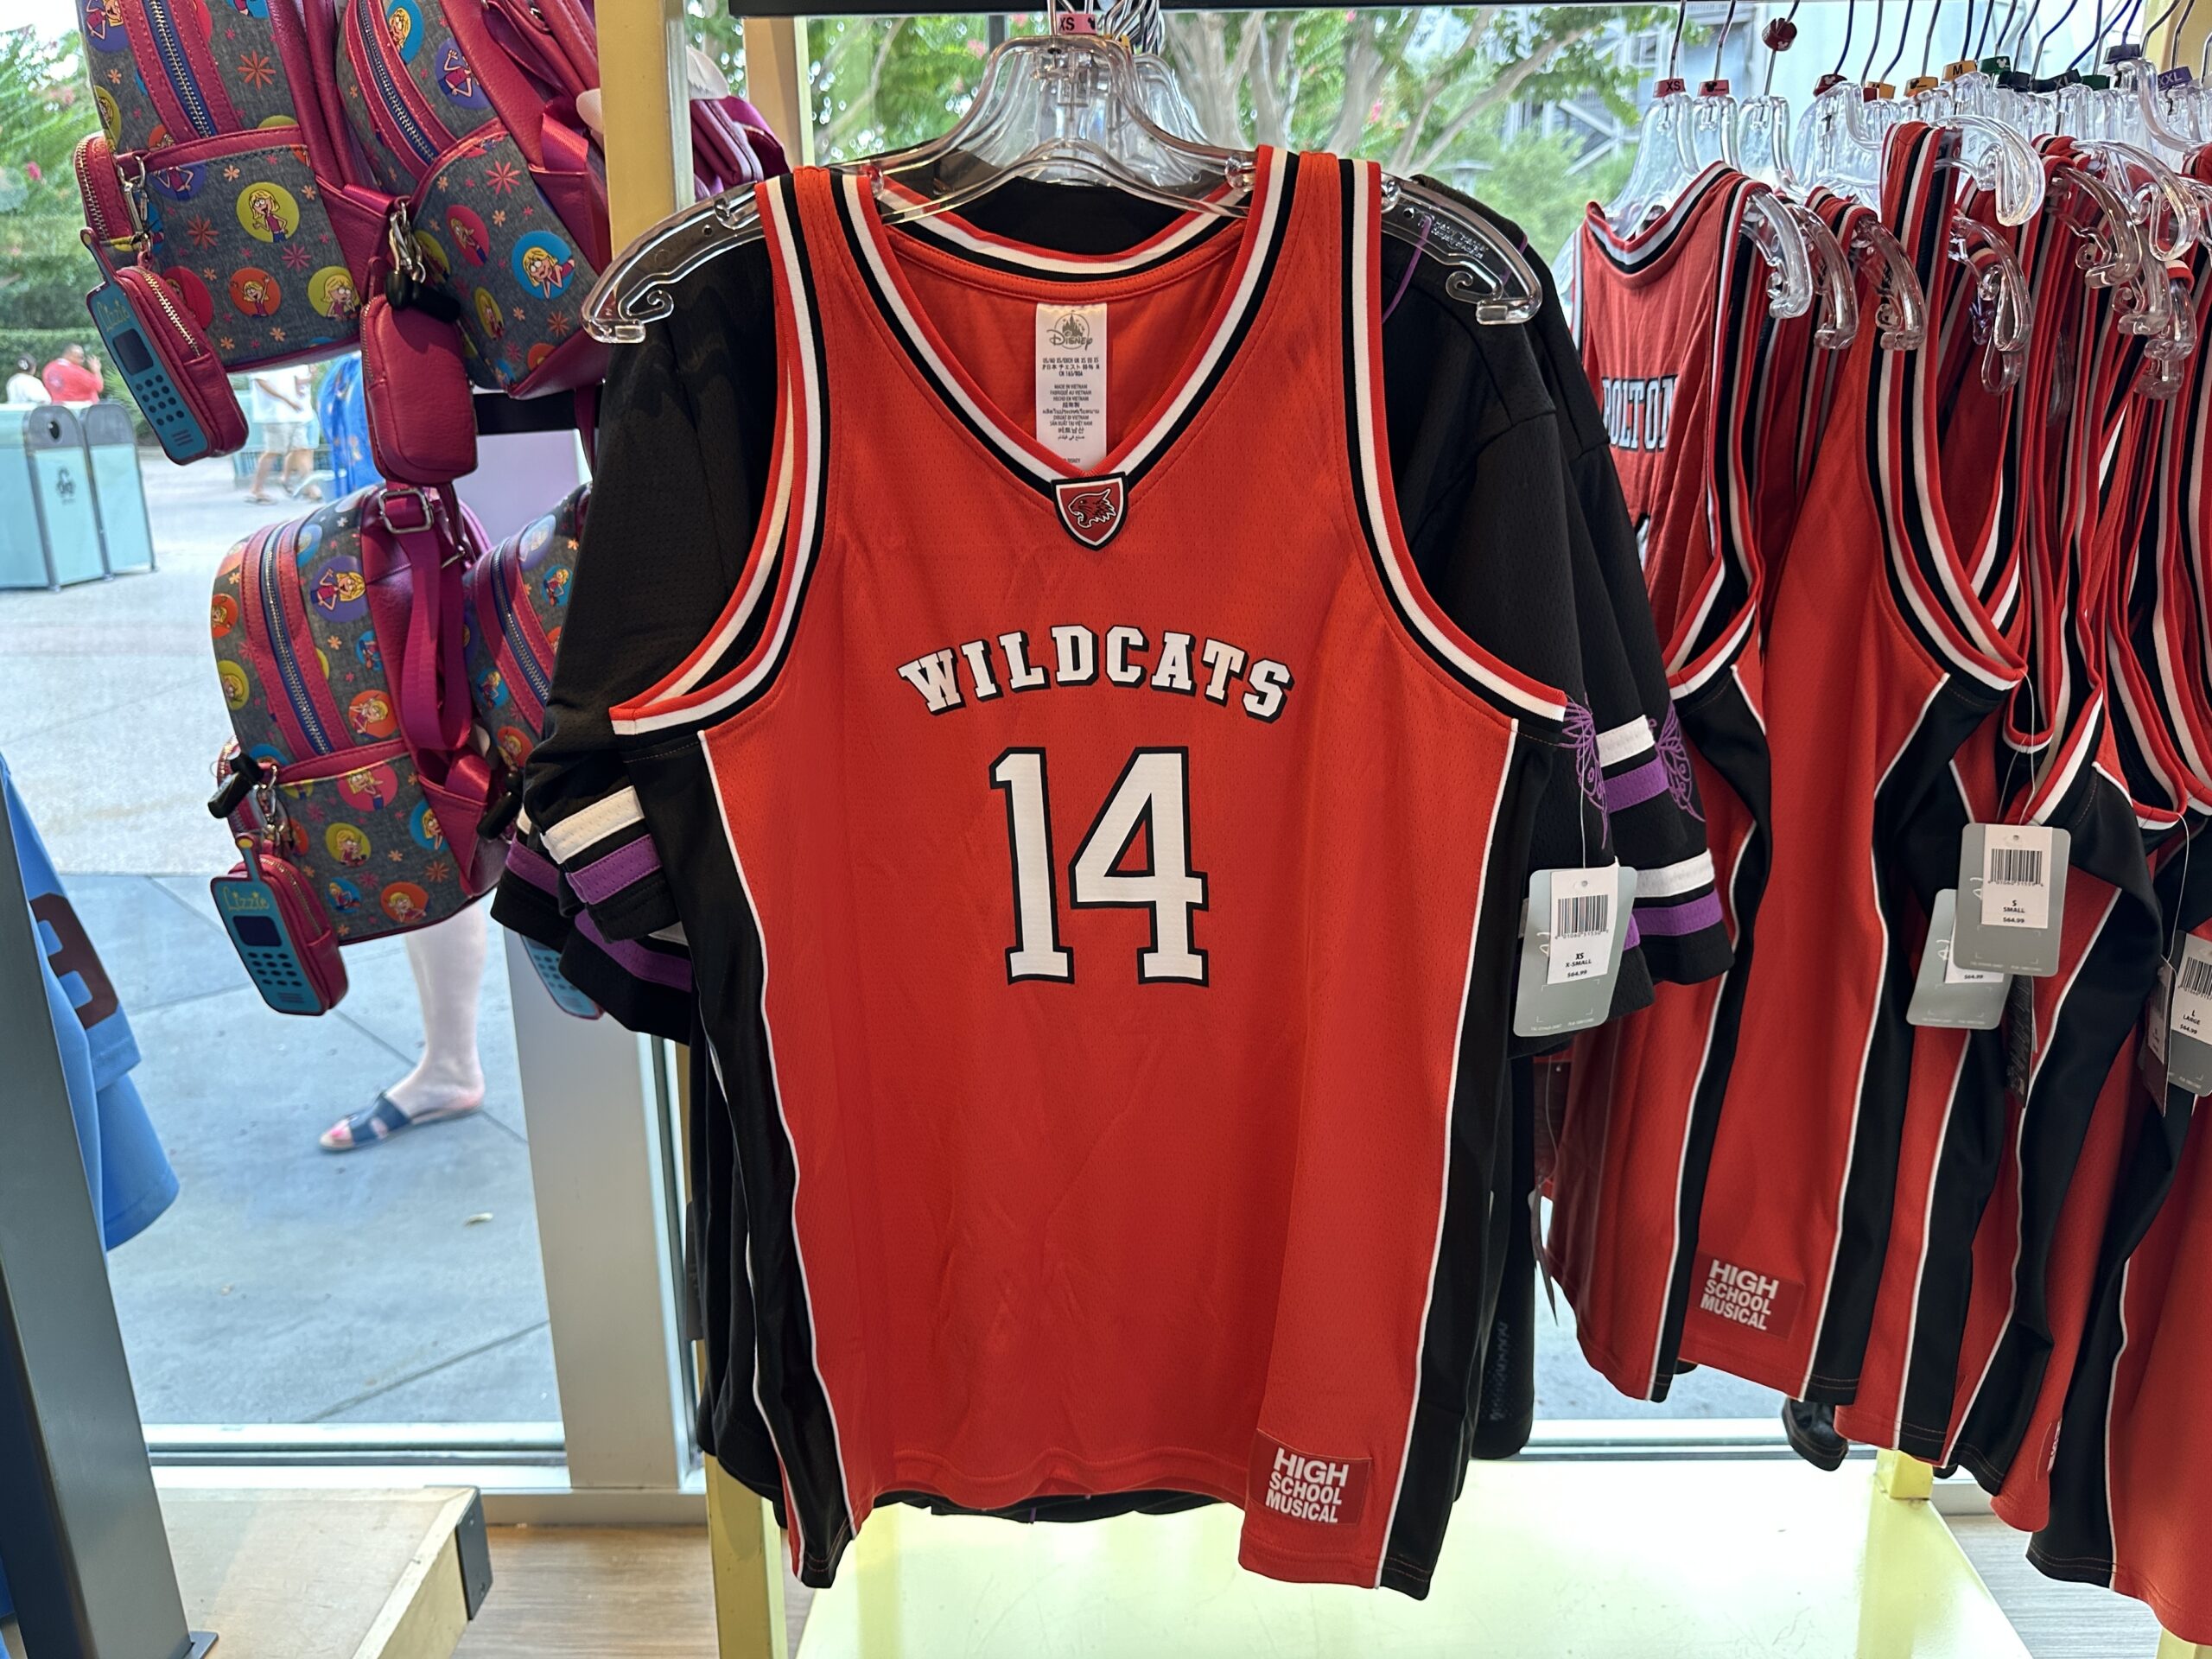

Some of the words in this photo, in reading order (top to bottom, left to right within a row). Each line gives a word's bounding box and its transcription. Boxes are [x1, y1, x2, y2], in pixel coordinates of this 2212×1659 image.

[1953, 64, 1963, 75] M
[1666, 81, 1681, 92] XS
[897, 624, 1294, 723] WILDCATS
[989, 746, 1209, 987] 14
[222, 885, 270, 912] Lizzie
[1565, 959, 1592, 968] X-SMALL
[1567, 969, 1587, 978] $64.99
[2182, 1014, 2202, 1027] LARGE
[2190, 1008, 2196, 1018] L
[2179, 1023, 2198, 1035] $64.99
[1709, 1259, 1780, 1300] HIGH
[1700, 1293, 1768, 1332] MUSICAL
[1704, 1279, 1772, 1316] SCHOOL
[1273, 1446, 1350, 1488] HIGH
[1268, 1471, 1343, 1506] SCHOOL
[1264, 1488, 1338, 1523] MUSICAL
